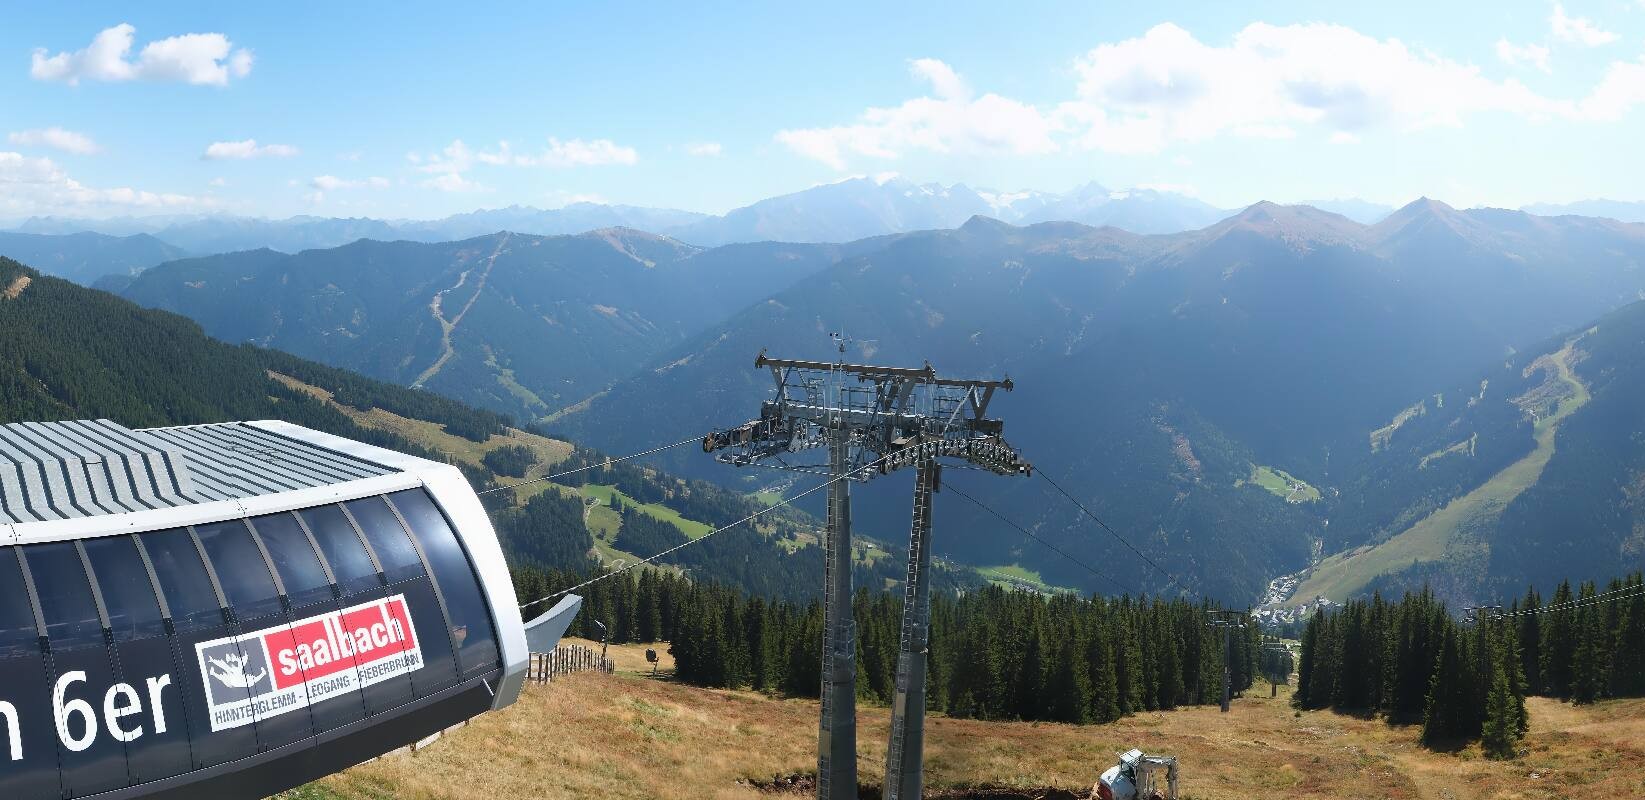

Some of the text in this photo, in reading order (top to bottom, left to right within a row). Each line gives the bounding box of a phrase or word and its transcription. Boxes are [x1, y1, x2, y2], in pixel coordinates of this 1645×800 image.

[278, 602, 405, 676] saalbach
[52, 670, 172, 752] 6er
[214, 691, 297, 724] HINTERGLEMM
